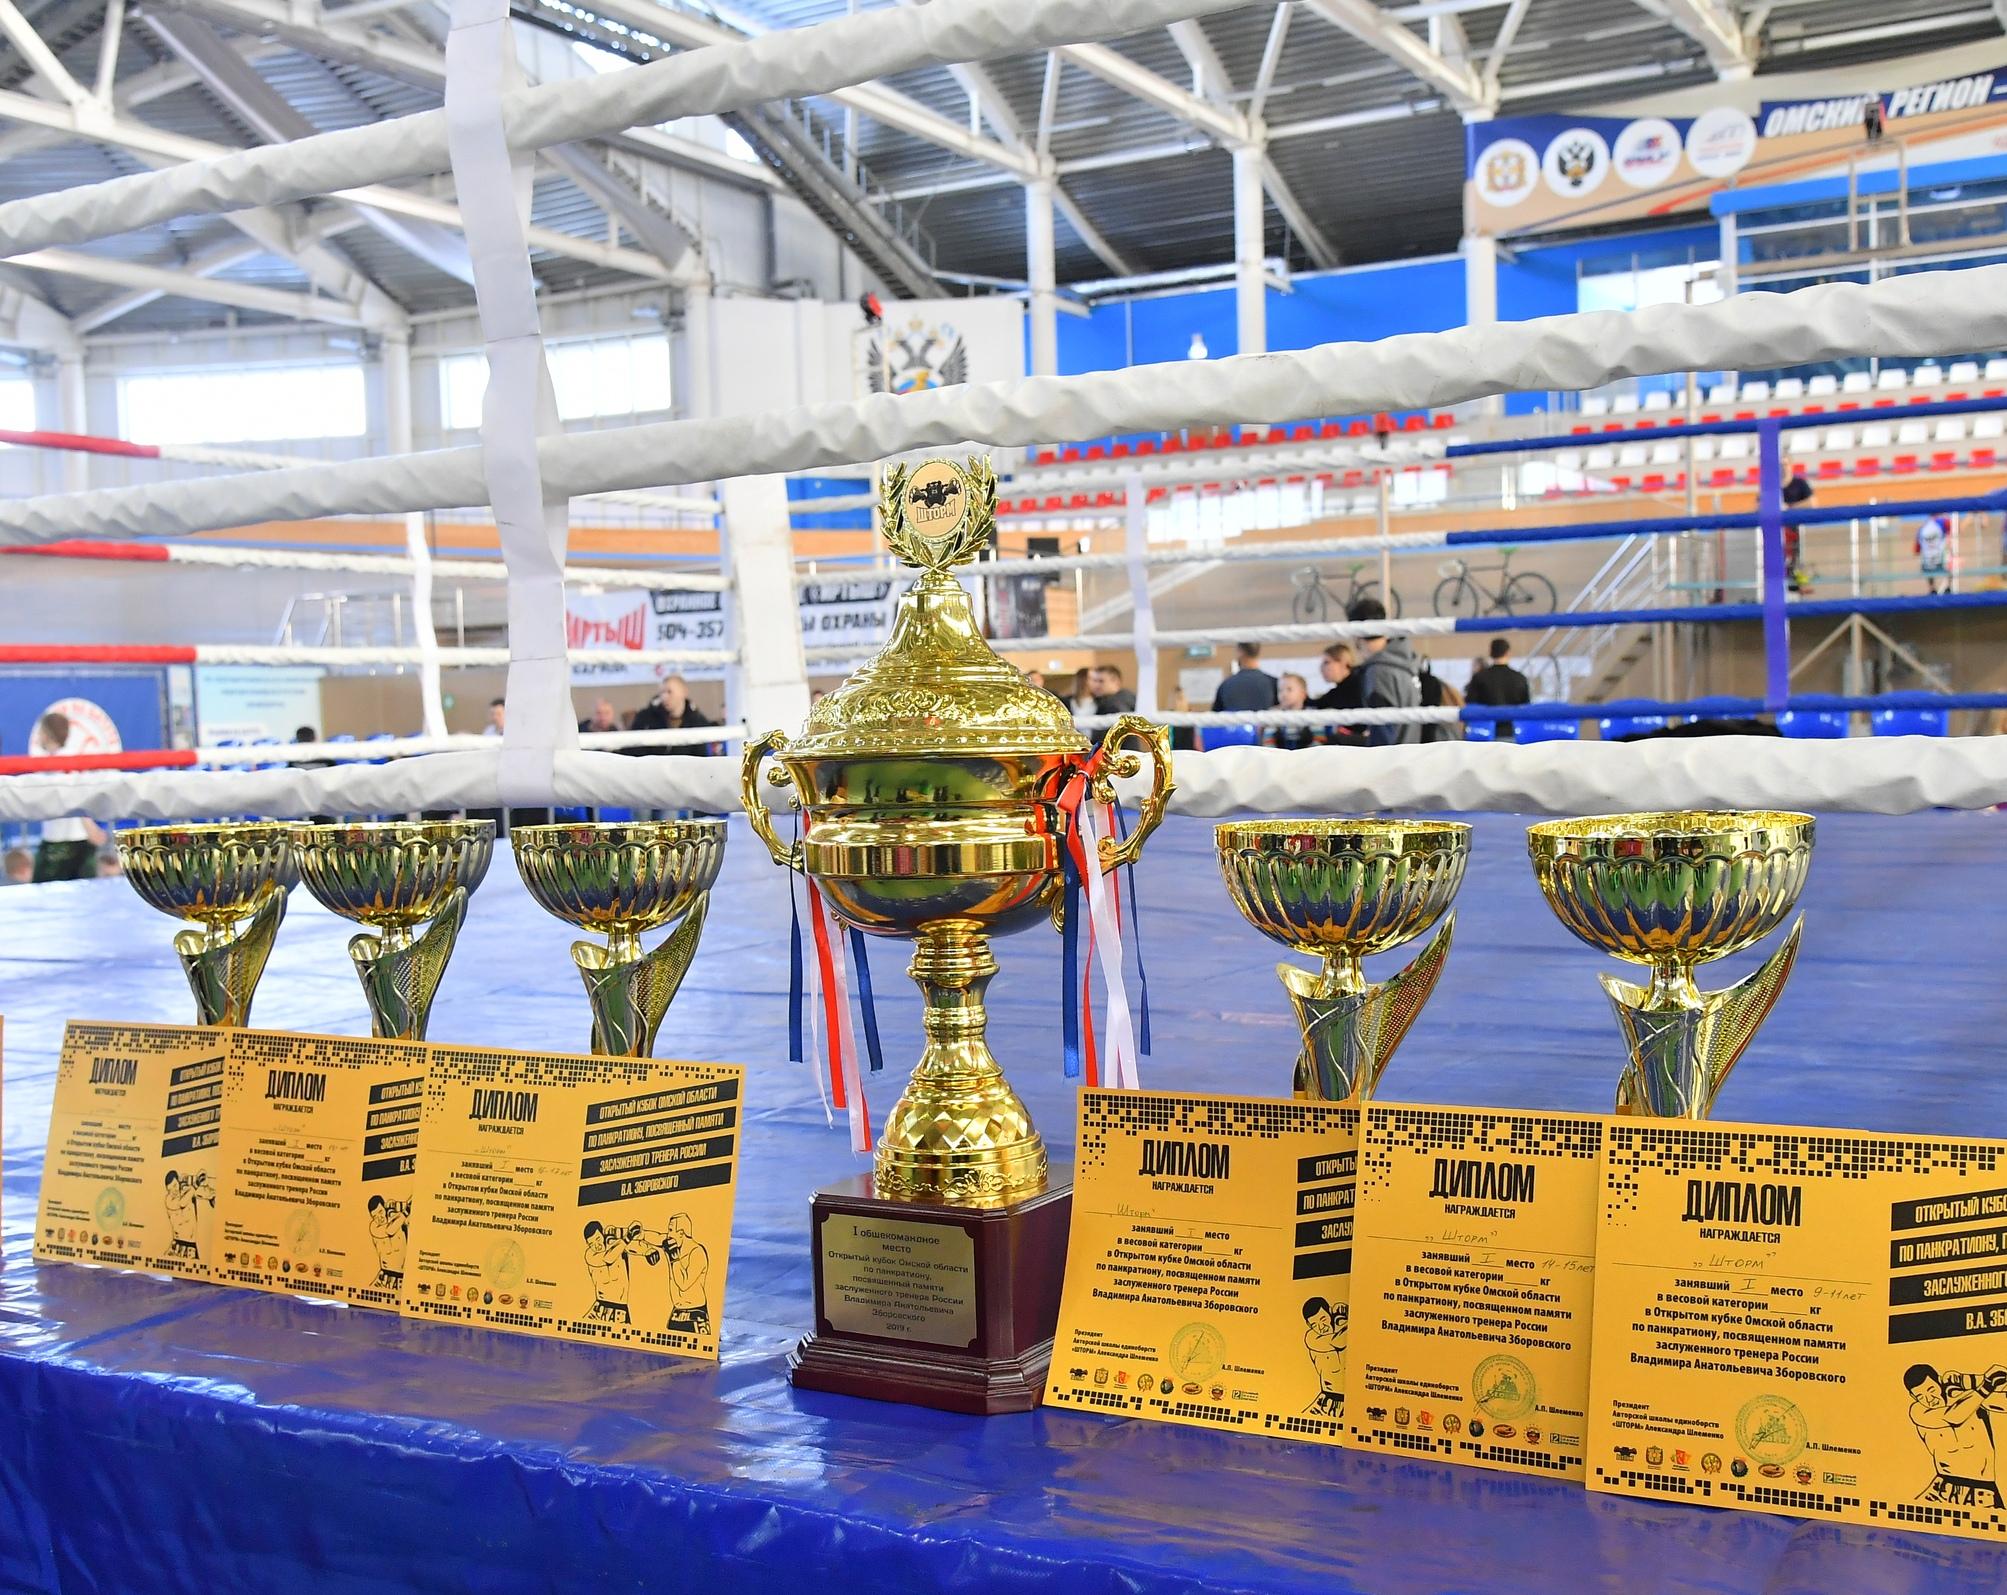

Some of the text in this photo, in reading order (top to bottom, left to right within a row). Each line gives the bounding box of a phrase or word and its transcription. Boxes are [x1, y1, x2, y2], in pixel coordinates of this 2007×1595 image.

[1886, 73, 1995, 119] РЕГИОН
[915, 498, 957, 524] ШТОРМ
[89, 1057, 138, 1085] ДИПЛОМ
[265, 1070, 326, 1102] ДИПЛОМ
[272, 1103, 314, 1114] НАГРАЖДАЕТСЯ
[469, 1089, 538, 1122] ДИПЛОМ
[600, 1086, 717, 1119] ОТКРЫТЫЙ КУБОК ОМСКОЙ ОБЛАСТИ
[477, 1123, 525, 1136] НАГРАЖДАЕТСЯ
[588, 1112, 724, 1148] ПО ПАНКРАТИОНУ, ПОСВЯЩЕННЫЙ ПАМЯТИ
[600, 1143, 706, 1172] ЗАСЛУЖЕННОГО ТРЕНЕРА РОССИИ
[1139, 1140, 1229, 1179] ДИПЛОМ
[621, 1175, 678, 1196] В.А. ЗБОРОВСКОГО
[1152, 1181, 1213, 1194] НАГРАЖДАЕТСЯ
[1429, 1158, 1535, 1203] ДИПЛОМ
[1304, 1195, 1314, 1210] ПО
[1445, 1204, 1515, 1219] НАГРАЖДАЕТСЯ
[1682, 1180, 1801, 1226] ДИПЛОМ
[1916, 1196, 1979, 1222] ОТКРЫТЫЙ
[1131, 1224, 1175, 1236] занявший
[1204, 1231, 1231, 1241] место
[1700, 1228, 1780, 1243] НАГРАЖДАЕТСЯ
[881, 1243, 912, 1254] место
[1117, 1237, 1244, 1256] в весовой категории кг
[1900, 1245, 1913, 1262] ПО
[1916, 1234, 1999, 1260] ПАНКРАТИОНУ,
[828, 1250, 969, 1274] Открытый кубок Омской области
[863, 1266, 875, 1274] по
[1106, 1248, 1252, 1271] в Открытом кубке Омской области
[1421, 1251, 1471, 1264] занявший
[1505, 1259, 1535, 1270] место
[1095, 1262, 1261, 1286] по панкратиону, посвященном памяти
[1405, 1264, 1551, 1287] в весовой категории кг
[835, 1283, 964, 1305] заслуженного тренера России
[1113, 1278, 1239, 1299] заслуженного тренера России
[1394, 1277, 1561, 1303] в Открытом кубке Омской области
[1674, 1278, 1730, 1292] занявший
[1770, 1286, 1804, 1297] место
[844, 1294, 954, 1314] Владимира Анатольевича
[1093, 1288, 1258, 1314] Владимира Анатольевича Зборовского
[1383, 1292, 1572, 1320] по панкратиону, посвященном памяти
[1656, 1293, 1822, 1315] в весовой категории кг
[1404, 1310, 1548, 1333] заслуженного тренера России
[1644, 1307, 1834, 1333] в Открытом кубке Омской области
[1966, 1312, 1987, 1330] В.А.
[1382, 1320, 1571, 1350] Владимира Анатольевича Зборовского
[1631, 1322, 1847, 1351] по панкратиону, посвященном памяти
[1656, 1341, 1818, 1364] заслуженного тренера России
[1365, 1363, 1399, 1374] Президент
[1631, 1352, 1845, 1383] Владимира Анатольевича Зборовского
[1364, 1382, 1464, 1402] «ШТОРМ» Александра Шлеменко
[1365, 1373, 1460, 1392] Авторской школы единоборств
[1534, 1403, 1584, 1418] А.П. Шлеменко
[1612, 1399, 1650, 1411] Президент
[1611, 1409, 1720, 1429] Авторской школы единоборств
[1611, 1420, 1725, 1440] «ШТОРМ» Александра Шлеменко
[1805, 1441, 1862, 1455] А.П. Шлеменко
